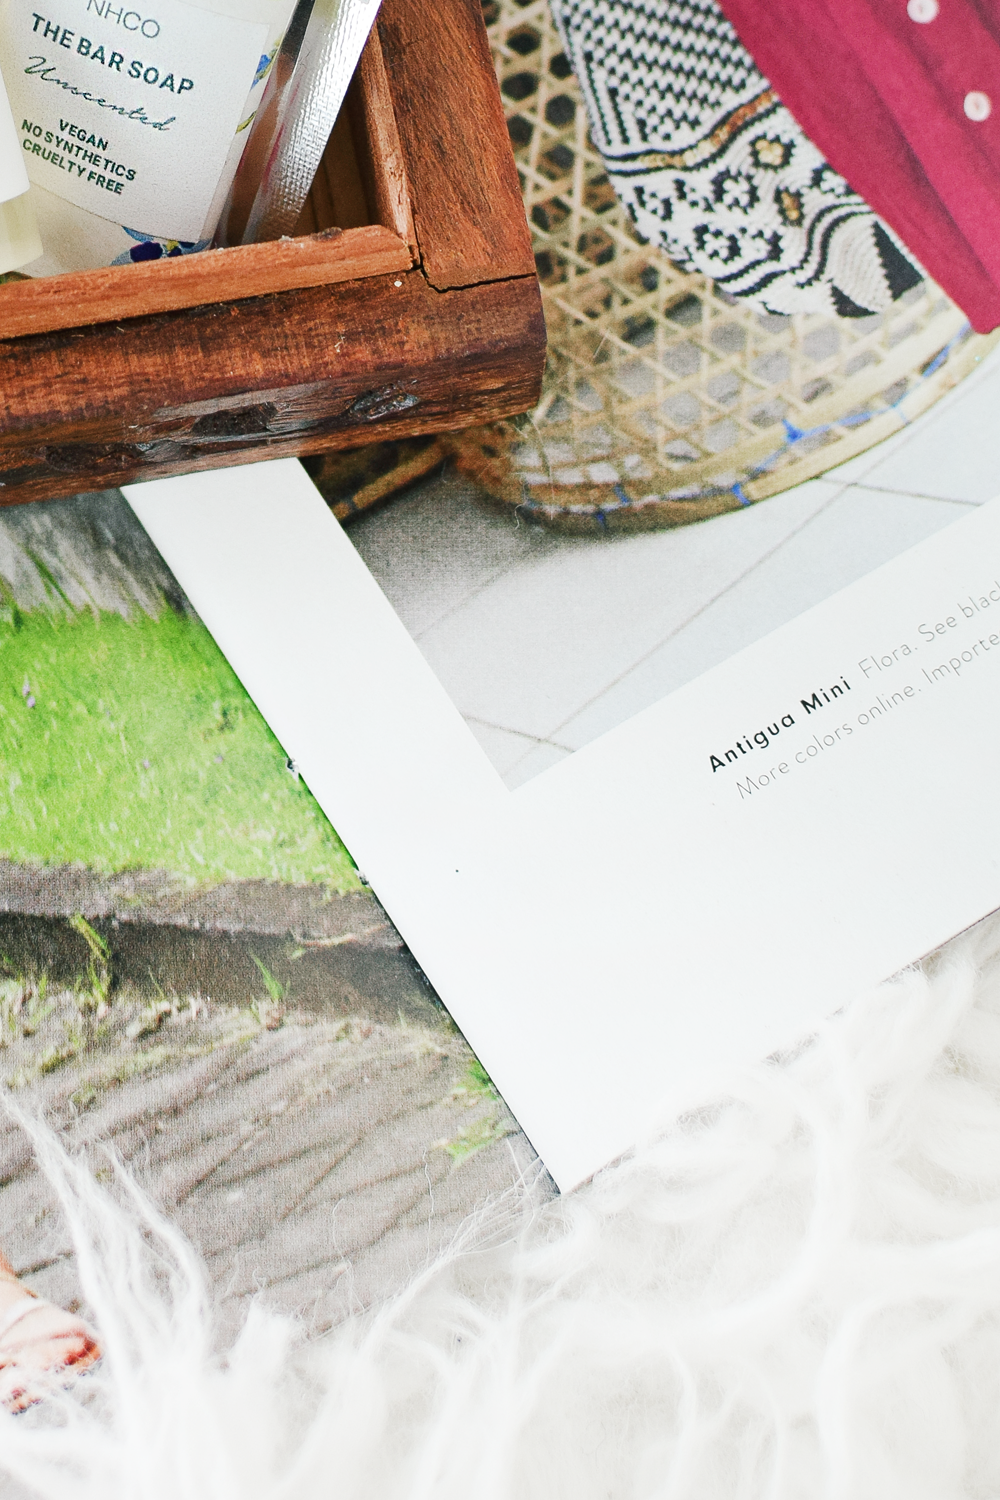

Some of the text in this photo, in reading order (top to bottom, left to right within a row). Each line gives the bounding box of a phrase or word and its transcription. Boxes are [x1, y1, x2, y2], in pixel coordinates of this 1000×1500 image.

[23, 54, 177, 132] Unscented
[31, 12, 195, 96] THE BAR SOAP
[21, 118, 137, 181] NO SYNTHETICS
[22, 138, 125, 196] CRUELTY FREE
[58, 118, 109, 152] VEGAN
[708, 580, 1000, 773] Antigua Mini Flora. See blac
[735, 630, 1000, 800] More colors online. Importe
